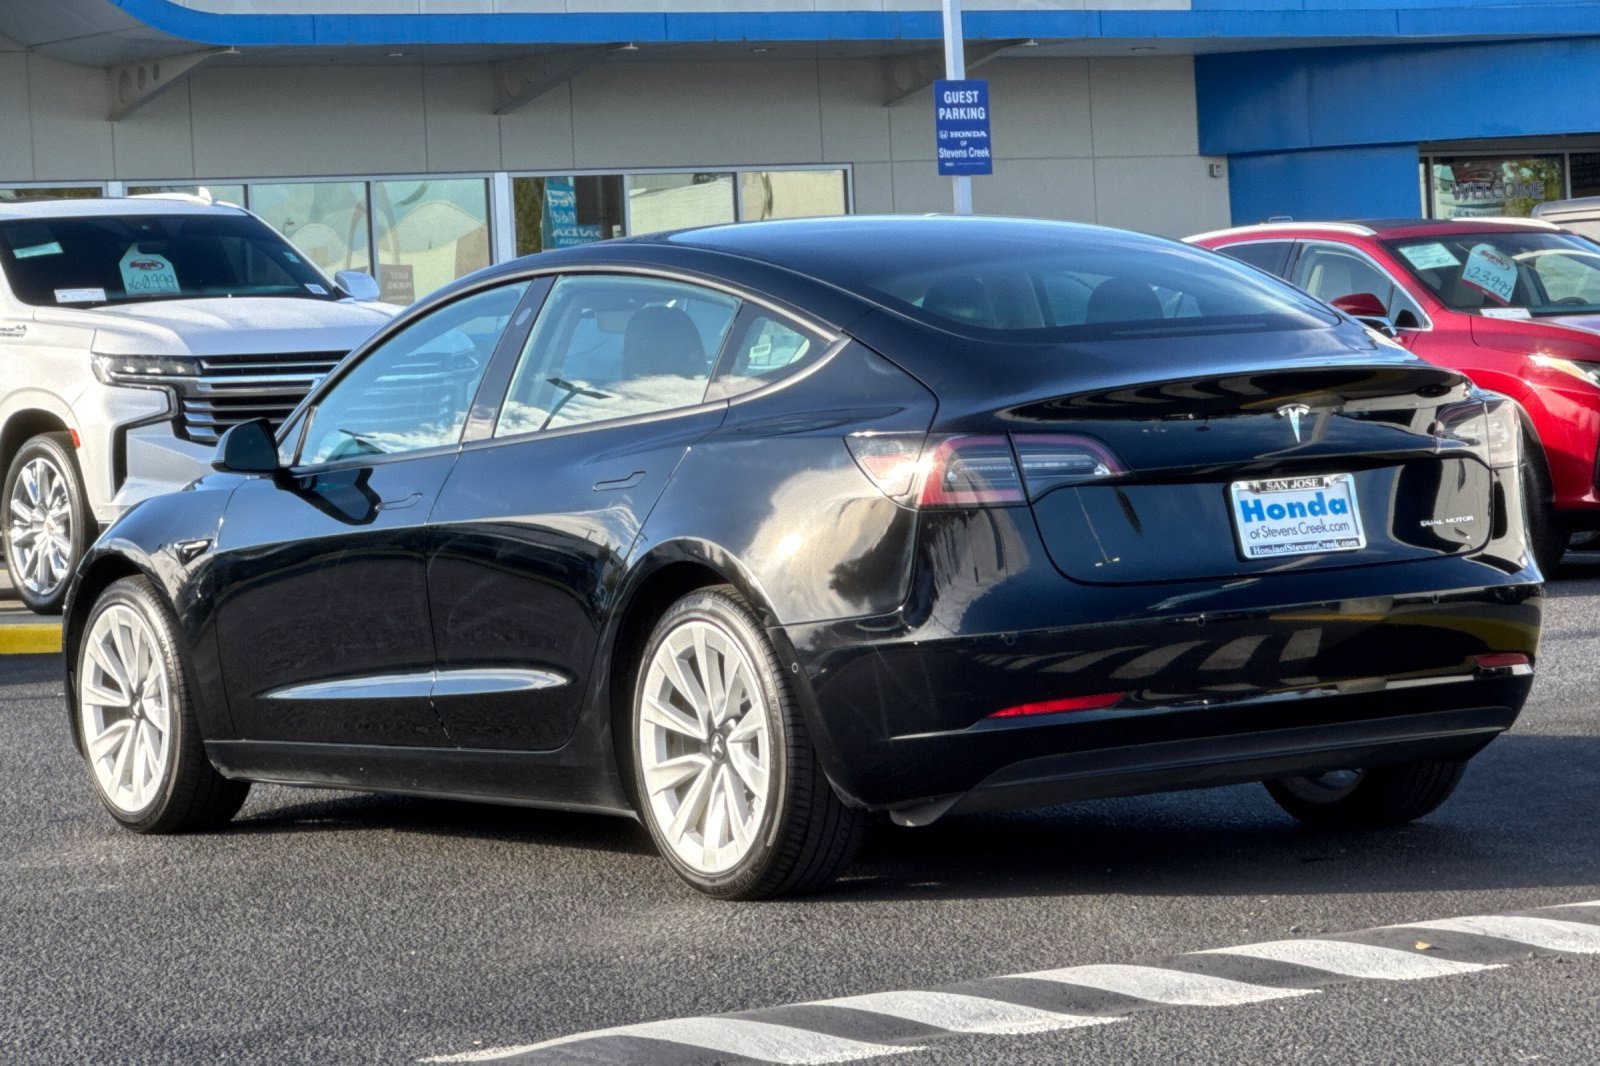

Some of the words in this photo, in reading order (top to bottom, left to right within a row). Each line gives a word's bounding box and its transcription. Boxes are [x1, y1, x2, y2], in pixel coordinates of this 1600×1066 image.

[943, 90, 979, 104] GUEST
[938, 106, 986, 120] PARKING
[949, 130, 987, 138] HONDA
[938, 147, 967, 158] Stevens
[968, 146, 990, 158] Creek
[1450, 181, 1545, 201] WELCOME
[1265, 481, 1289, 491] SAN
[1290, 478, 1320, 489] JOSE
[1240, 491, 1349, 523] Honda
[1446, 515, 1474, 524] MOTOR
[1250, 528, 1261, 539] of
[1261, 524, 1298, 539] Stevens
[1299, 519, 1351, 537] Creek.com
[1253, 539, 1359, 556] HondaofStevensCreek.com
